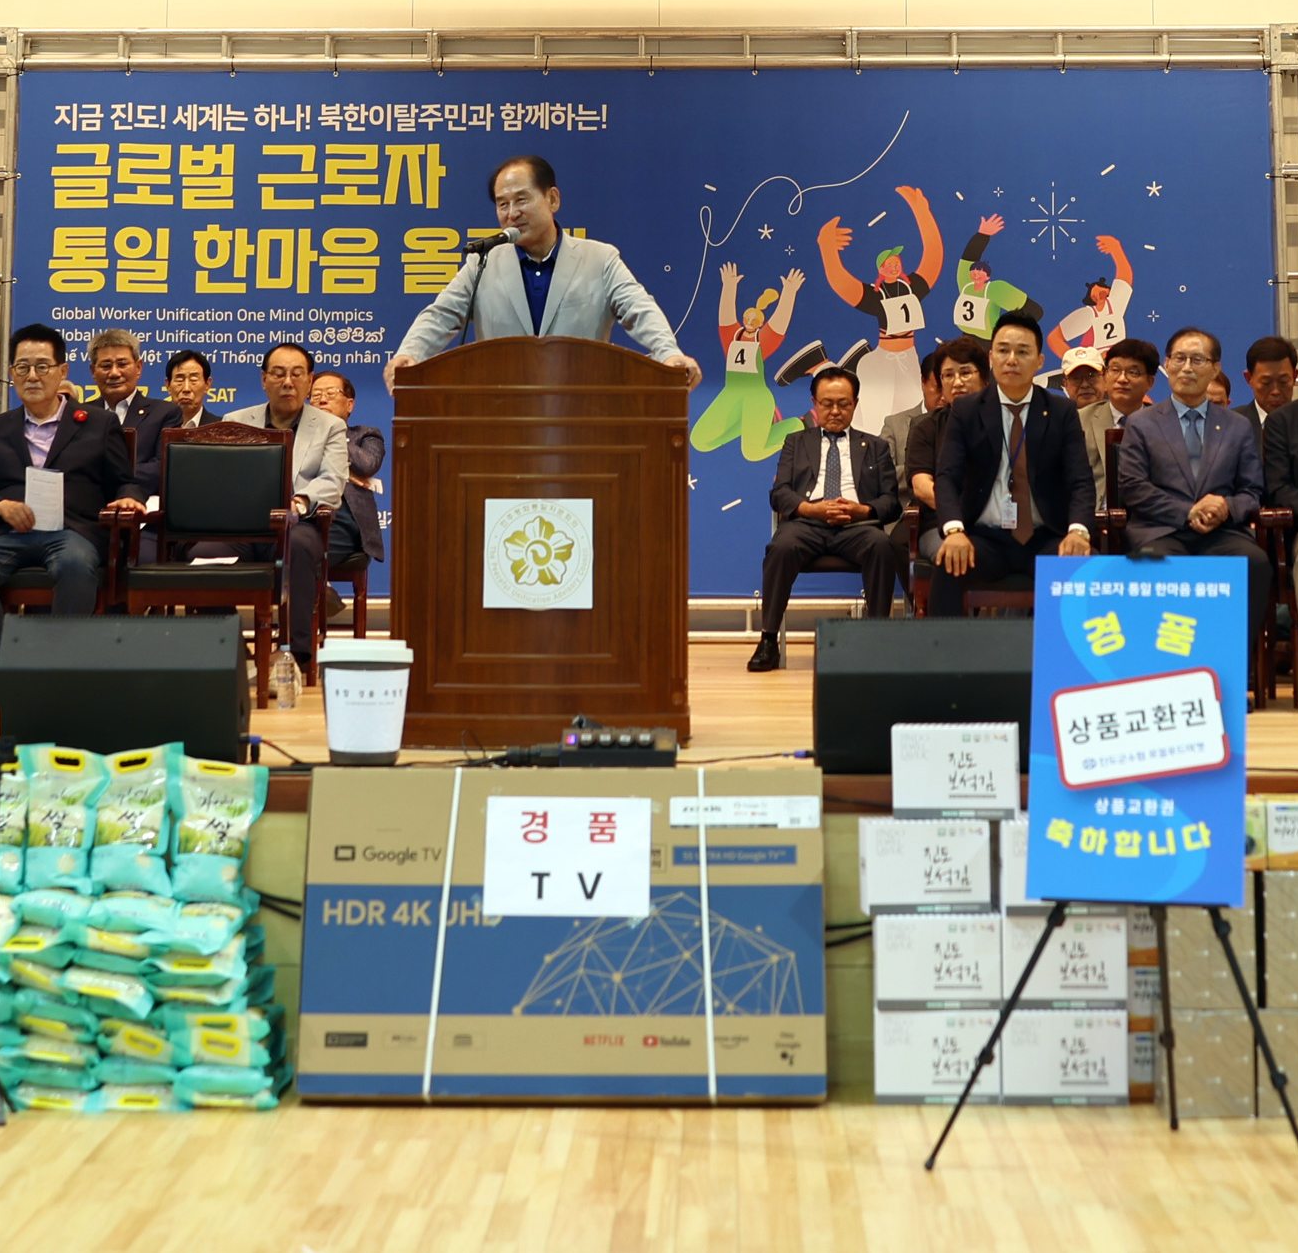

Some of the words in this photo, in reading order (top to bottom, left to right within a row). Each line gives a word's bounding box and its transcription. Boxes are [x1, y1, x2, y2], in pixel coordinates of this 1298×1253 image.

[53, 102, 104, 132] 지금
[110, 102, 167, 131] 진도!
[172, 103, 249, 132] 세계는
[254, 103, 312, 133] 하나!
[317, 103, 495, 133] 북한이탈주민과
[500, 102, 609, 132] 함께하는!
[50, 143, 236, 211] 글로벌
[257, 142, 448, 210] 근로자
[47, 223, 169, 294] 통일
[193, 224, 381, 295] 한마음
[52, 307, 96, 321] Global
[99, 307, 153, 322] Worker
[156, 308, 234, 322] Unification
[237, 308, 266, 322] One
[269, 309, 303, 323] Mind
[308, 309, 374, 325] Olympics
[899, 302, 911, 326] 1
[961, 300, 975, 322] 3
[156, 329, 233, 344] Unification
[237, 330, 265, 344] One
[269, 330, 303, 344] Mind
[1102, 321, 1117, 342] 2
[219, 350, 264, 368] Thống
[345, 350, 381, 365] nhân
[733, 347, 747, 367] 4
[206, 387, 237, 403] SAT
[1068, 697, 1207, 746] 상품교환권
[1094, 797, 1176, 817] 상품교환권
[1046, 817, 1212, 858] 축하합니다
[362, 845, 418, 866] Google
[420, 846, 443, 863] TV
[322, 900, 386, 927] HDR
[392, 899, 432, 927] 4K
[582, 1034, 626, 1047] NETFLIX
